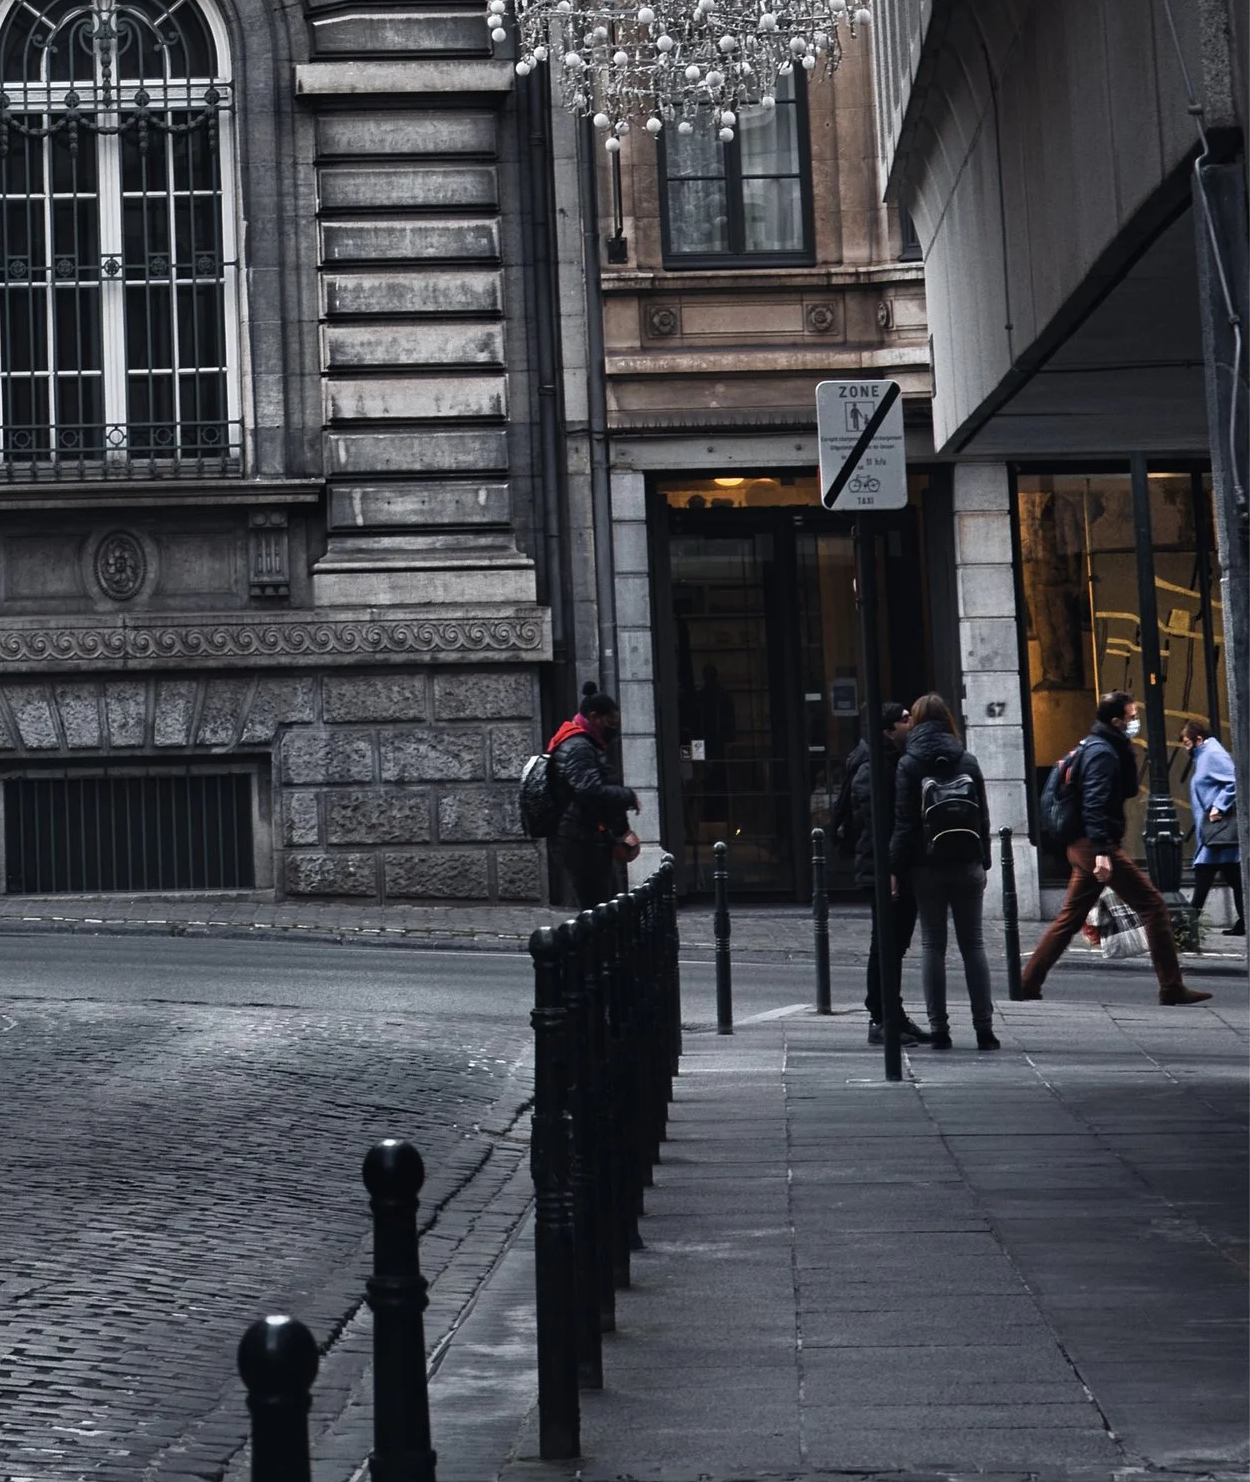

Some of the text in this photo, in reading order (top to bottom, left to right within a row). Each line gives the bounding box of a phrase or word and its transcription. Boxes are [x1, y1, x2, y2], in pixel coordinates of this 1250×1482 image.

[838, 385, 879, 398] ZONE
[857, 497, 874, 505] TAXI
[986, 701, 1006, 717] 67
